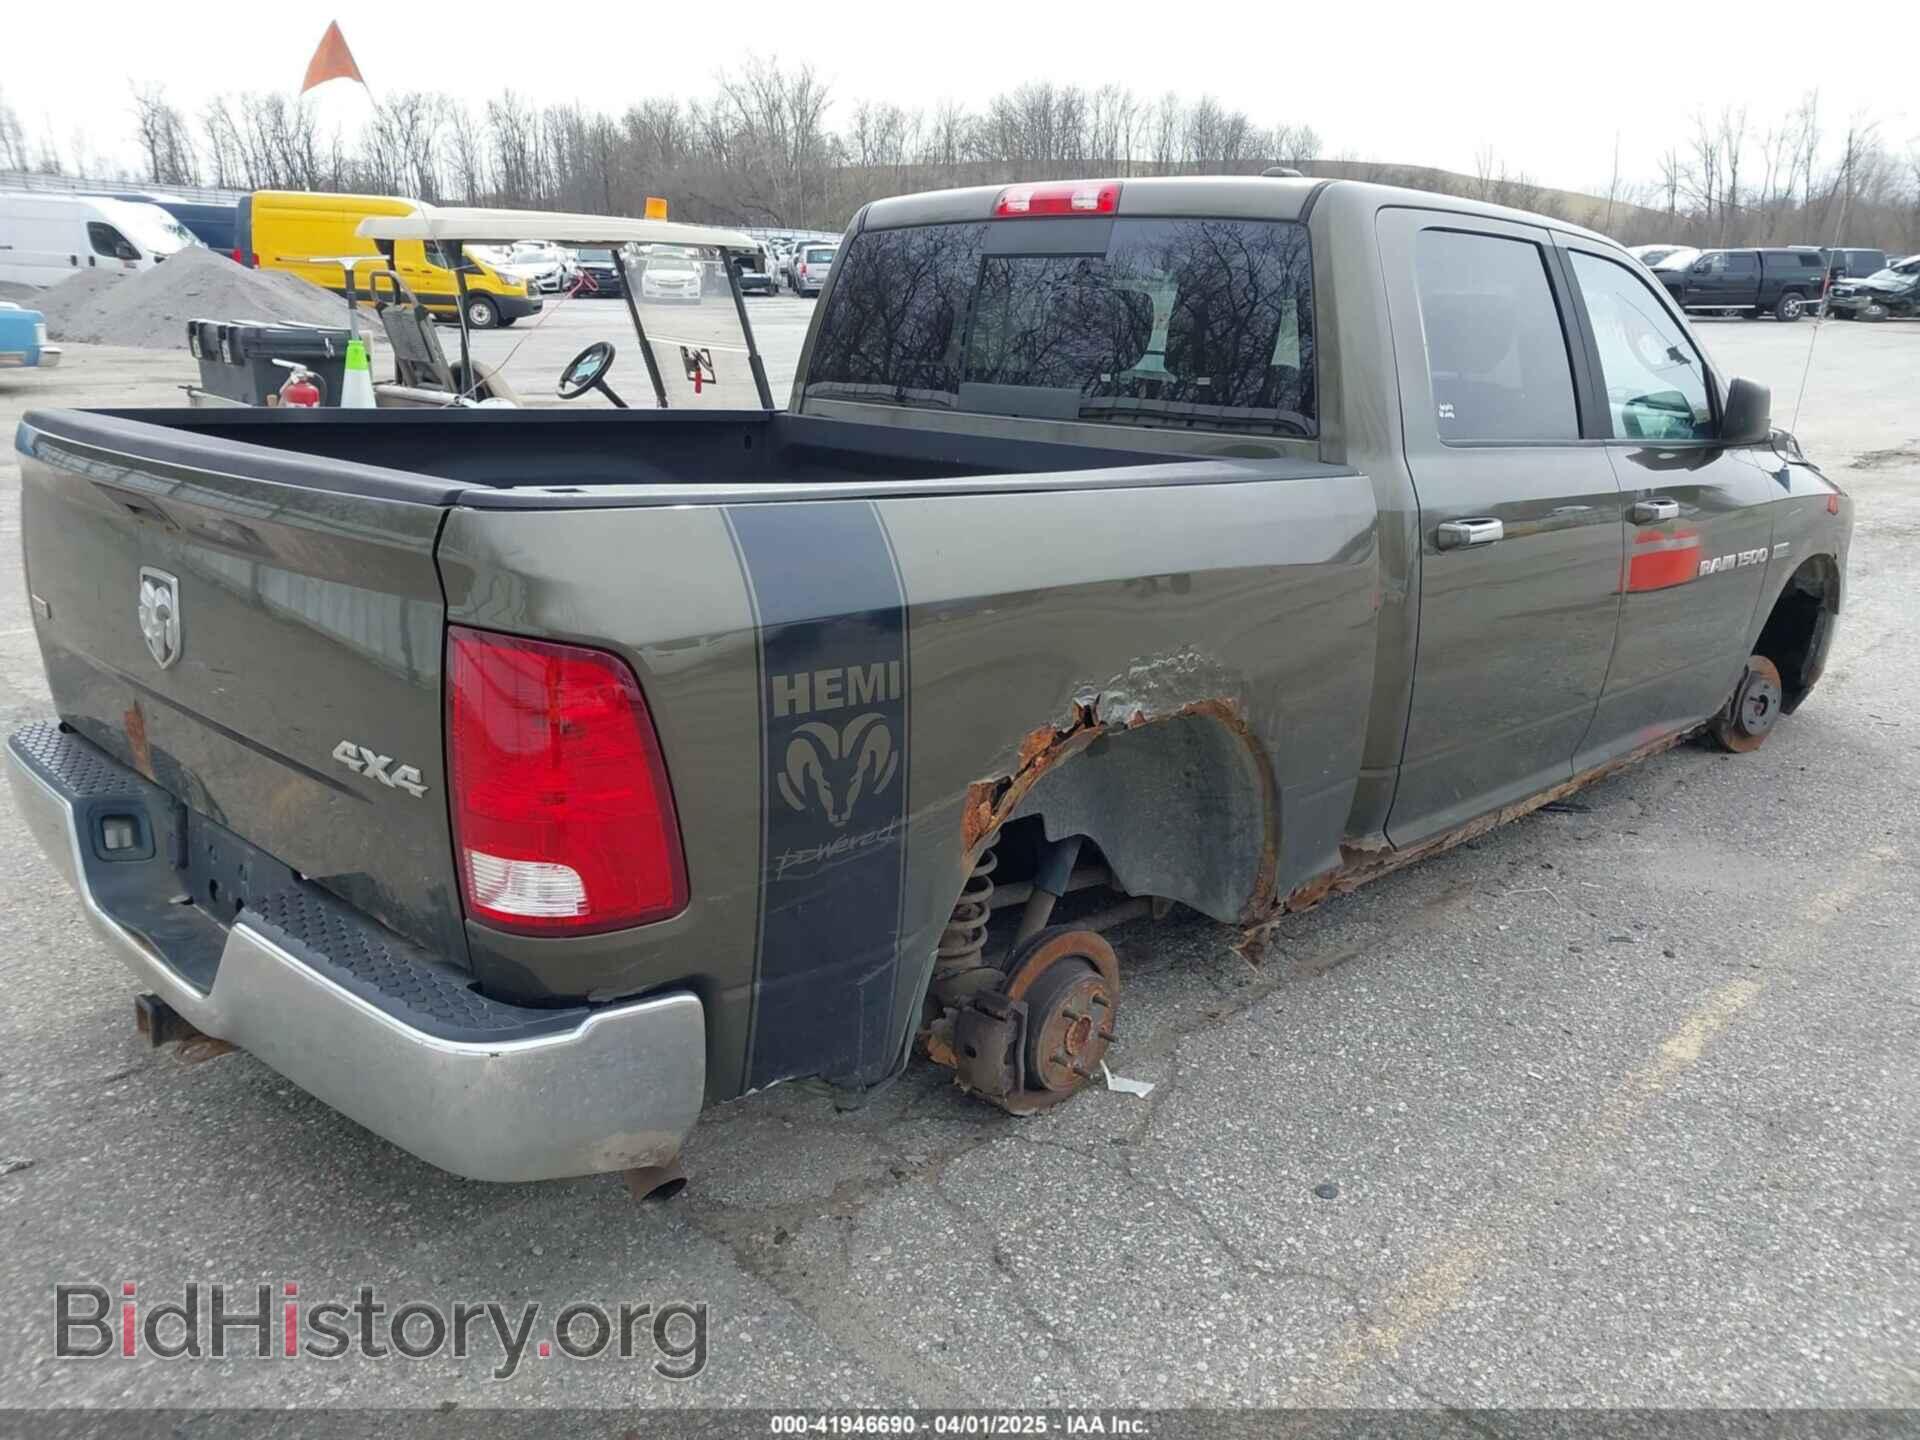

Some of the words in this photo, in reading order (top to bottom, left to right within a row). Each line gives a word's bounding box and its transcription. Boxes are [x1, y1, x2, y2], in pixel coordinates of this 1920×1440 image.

[1699, 554, 1736, 576] RAM
[1737, 547, 1768, 568] 1500
[772, 661, 901, 717] HEMI
